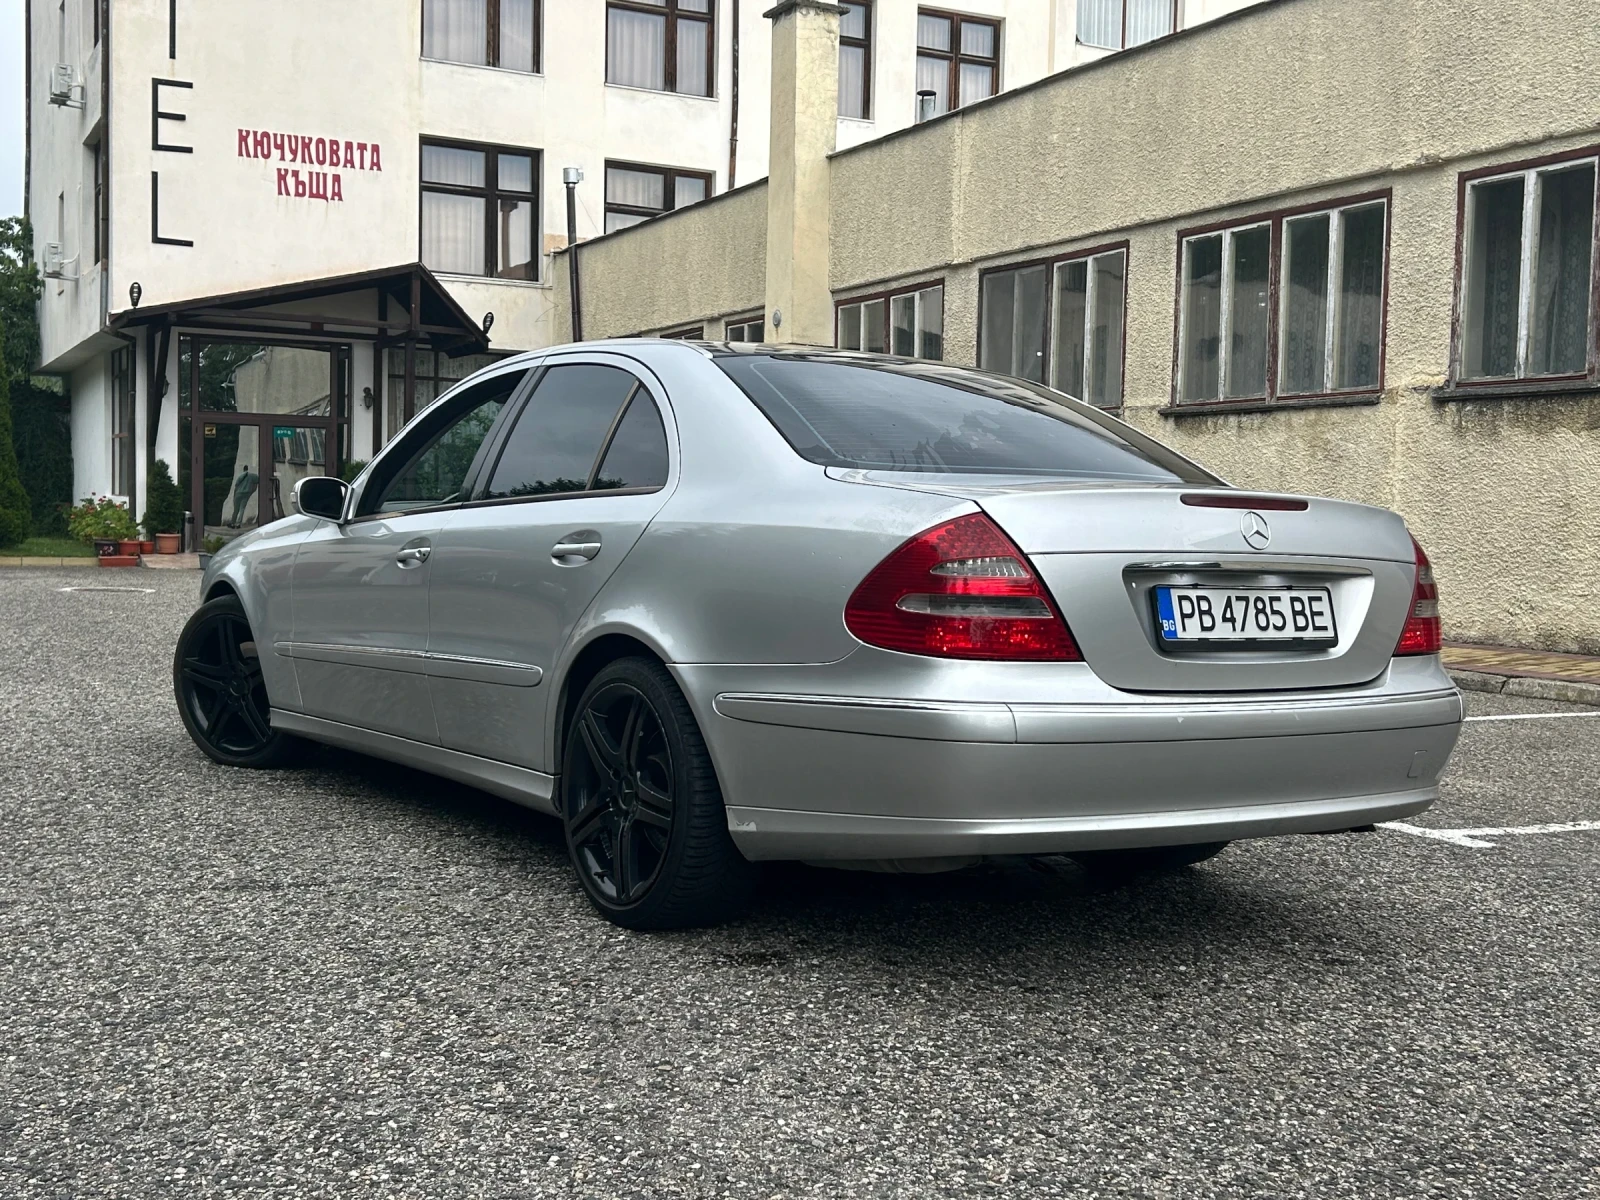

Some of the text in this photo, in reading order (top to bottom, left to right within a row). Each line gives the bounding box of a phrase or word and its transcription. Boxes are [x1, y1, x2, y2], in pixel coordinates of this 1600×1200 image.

[238, 129, 382, 171] КЮЧУКОВАТА
[276, 168, 343, 202] КЪЩА
[1163, 619, 1176, 631] BG
[1177, 595, 1329, 632] PB 4785 BE
